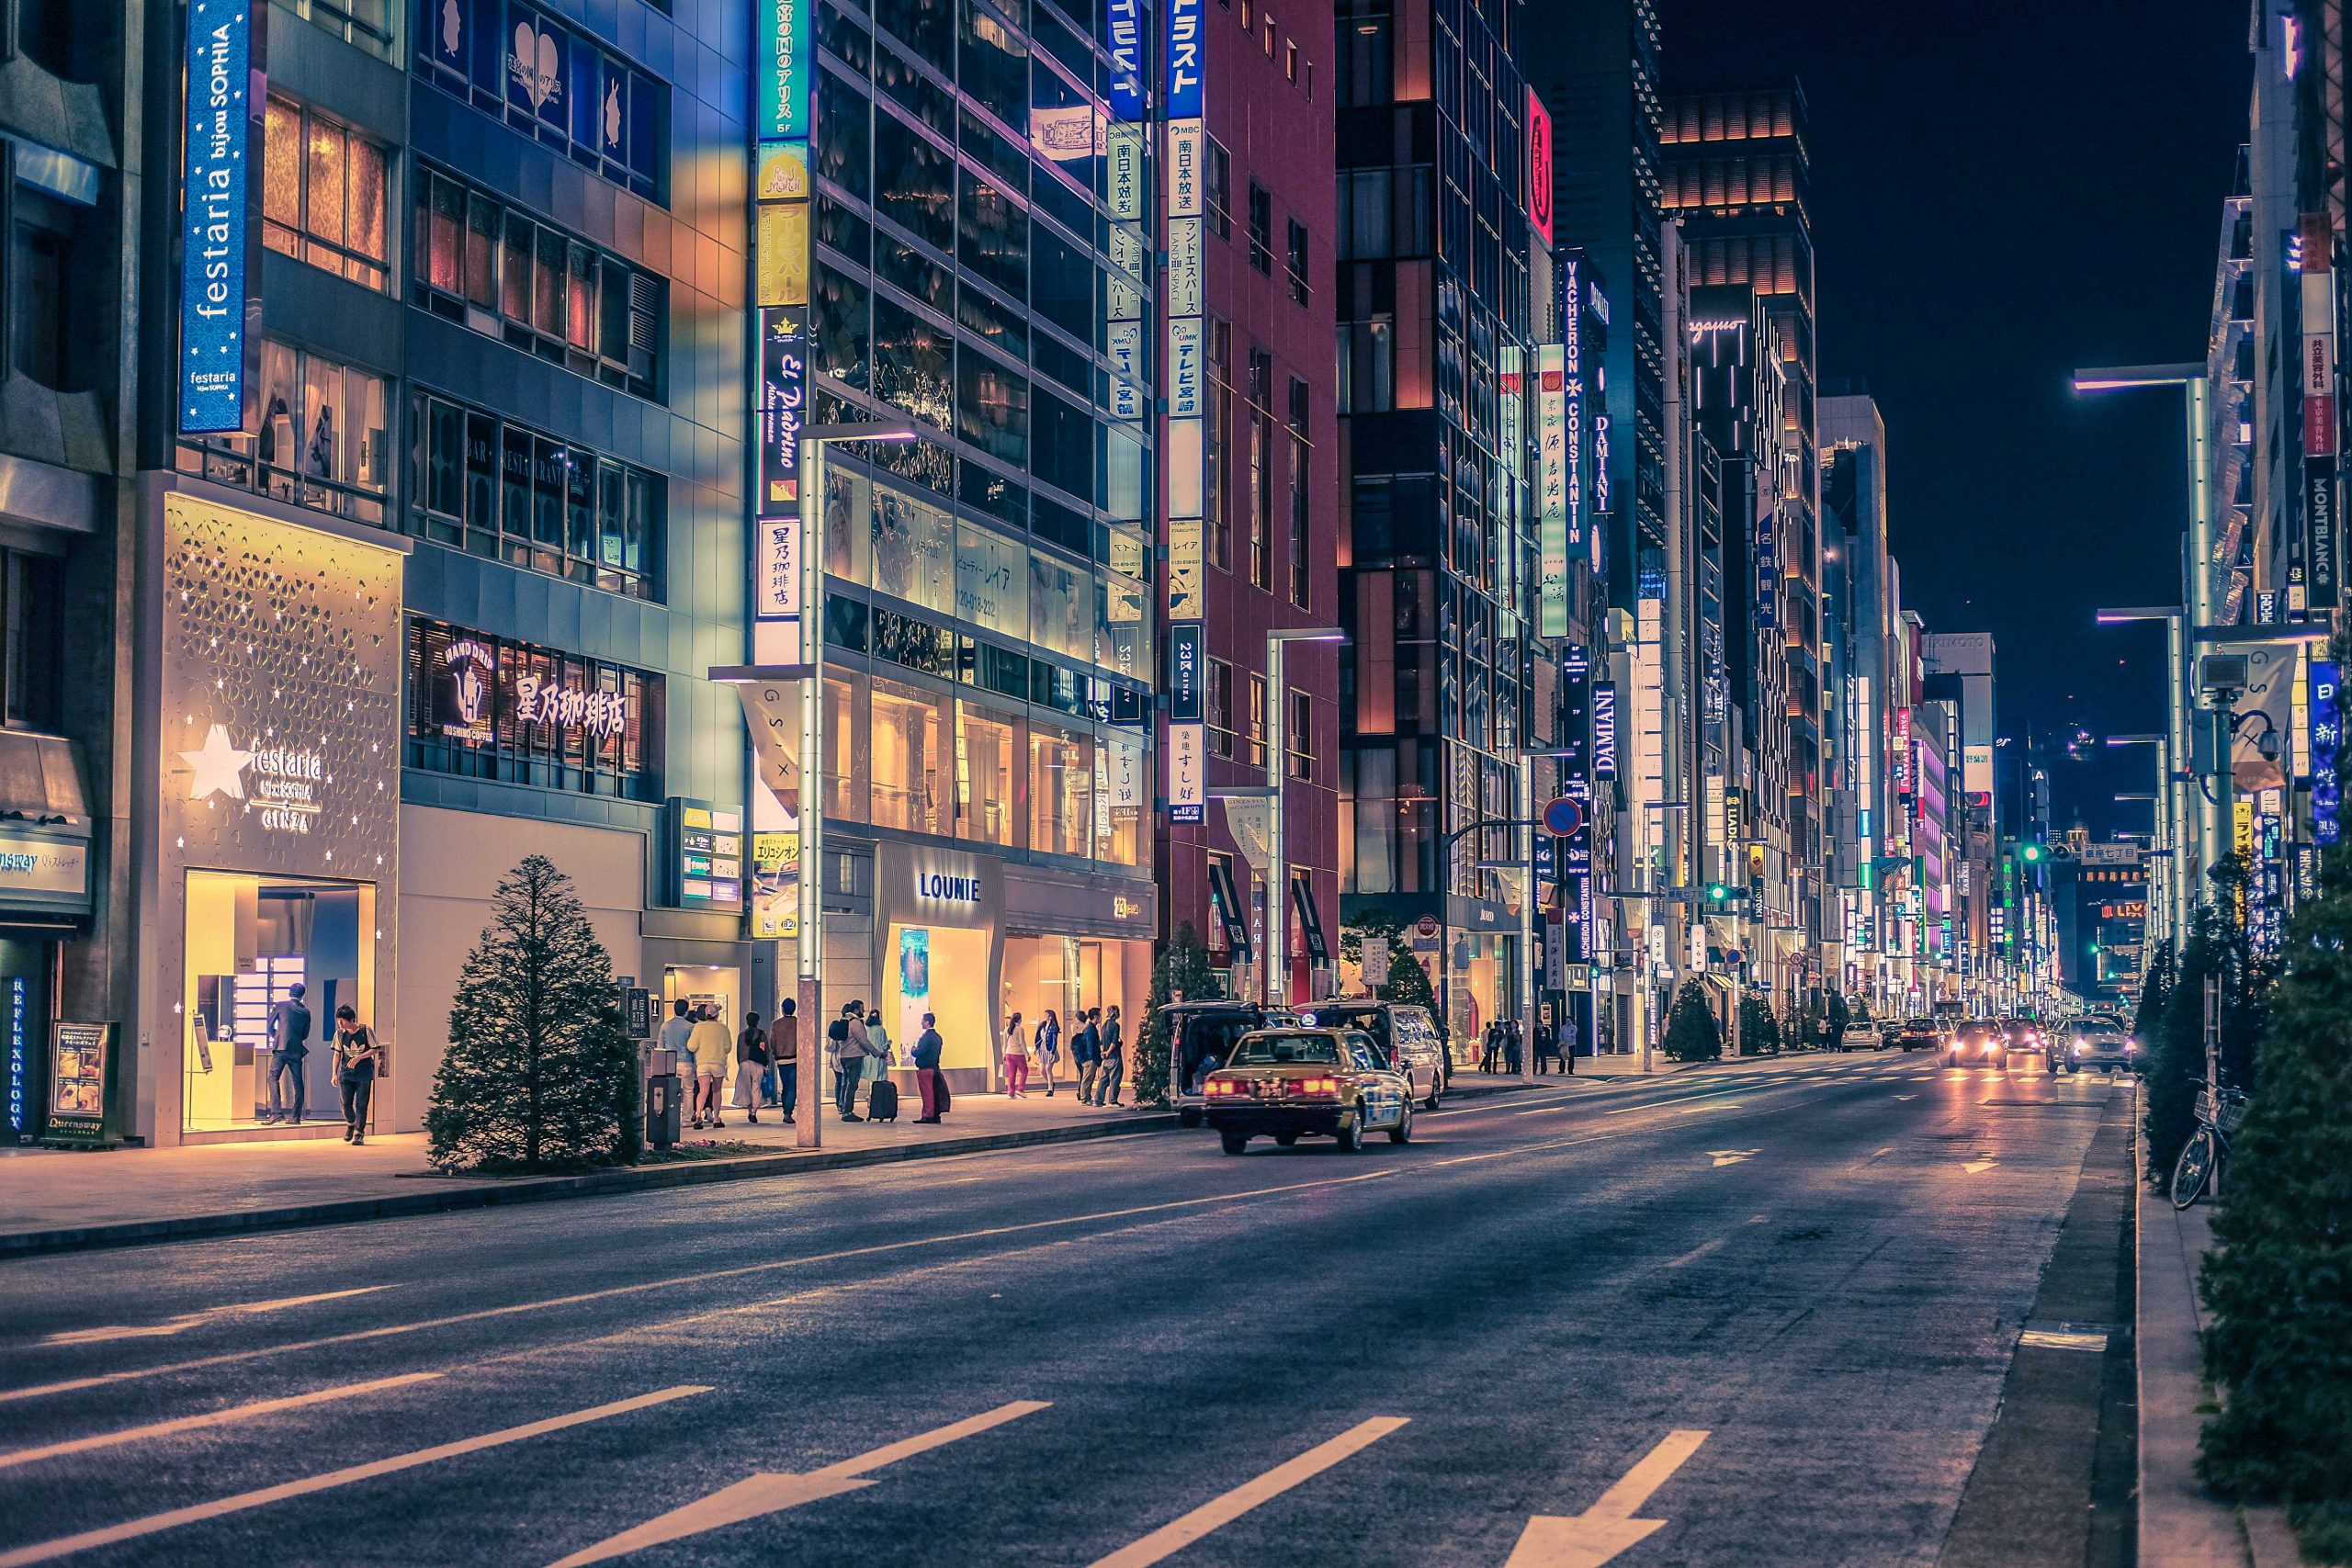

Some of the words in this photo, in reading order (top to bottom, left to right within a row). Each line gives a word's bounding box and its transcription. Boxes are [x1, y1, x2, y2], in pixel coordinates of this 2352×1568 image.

[209, 23, 231, 107] SOPHIA
[210, 110, 231, 159] bijou
[776, 123, 791, 133] 5F
[1181, 126, 1200, 135] MBC
[1178, 140, 1192, 209] 南日本放送
[196, 168, 230, 320] festaria
[1170, 232, 1180, 259] LAND
[1184, 220, 1196, 314] ランドエスパース
[1170, 268, 1181, 303] ESPACE
[1178, 333, 1198, 342] UMK
[1566, 261, 1579, 374] VACHERON
[190, 371, 236, 384] festaria
[1177, 344, 1195, 412] テレビ宮崎
[2312, 339, 2324, 389] 共立美容外科
[467, 435, 487, 462] BAR
[775, 385, 802, 468] Padrino
[1568, 402, 1580, 544] CONSTANTIN
[1596, 416, 1609, 512] DAMIANI
[1173, 541, 1198, 551] レイア
[2313, 478, 2329, 572] MONTBLANC
[772, 526, 790, 605] 星乃珈琲店
[985, 558, 1011, 590] レイア
[1759, 533, 1773, 615] 名鉄観光
[445, 642, 471, 664] HAND
[471, 646, 493, 671] DRIP
[516, 676, 626, 740] 星乃珈琲店
[2244, 649, 2269, 748] GSX
[471, 727, 493, 742] COFFEE
[1596, 690, 1615, 773] DAMIANI
[252, 739, 322, 780] festaria
[263, 810, 311, 830] GINZA
[2086, 848, 2134, 858] 銀座七丁目
[920, 872, 981, 902] LOUNIE
[1580, 876, 1589, 920] CONSTANTIN
[1580, 921, 1589, 960] VACHERON
[10, 979, 24, 1130] REFLEXOLOGY
[49, 1117, 102, 1132] Queensway
